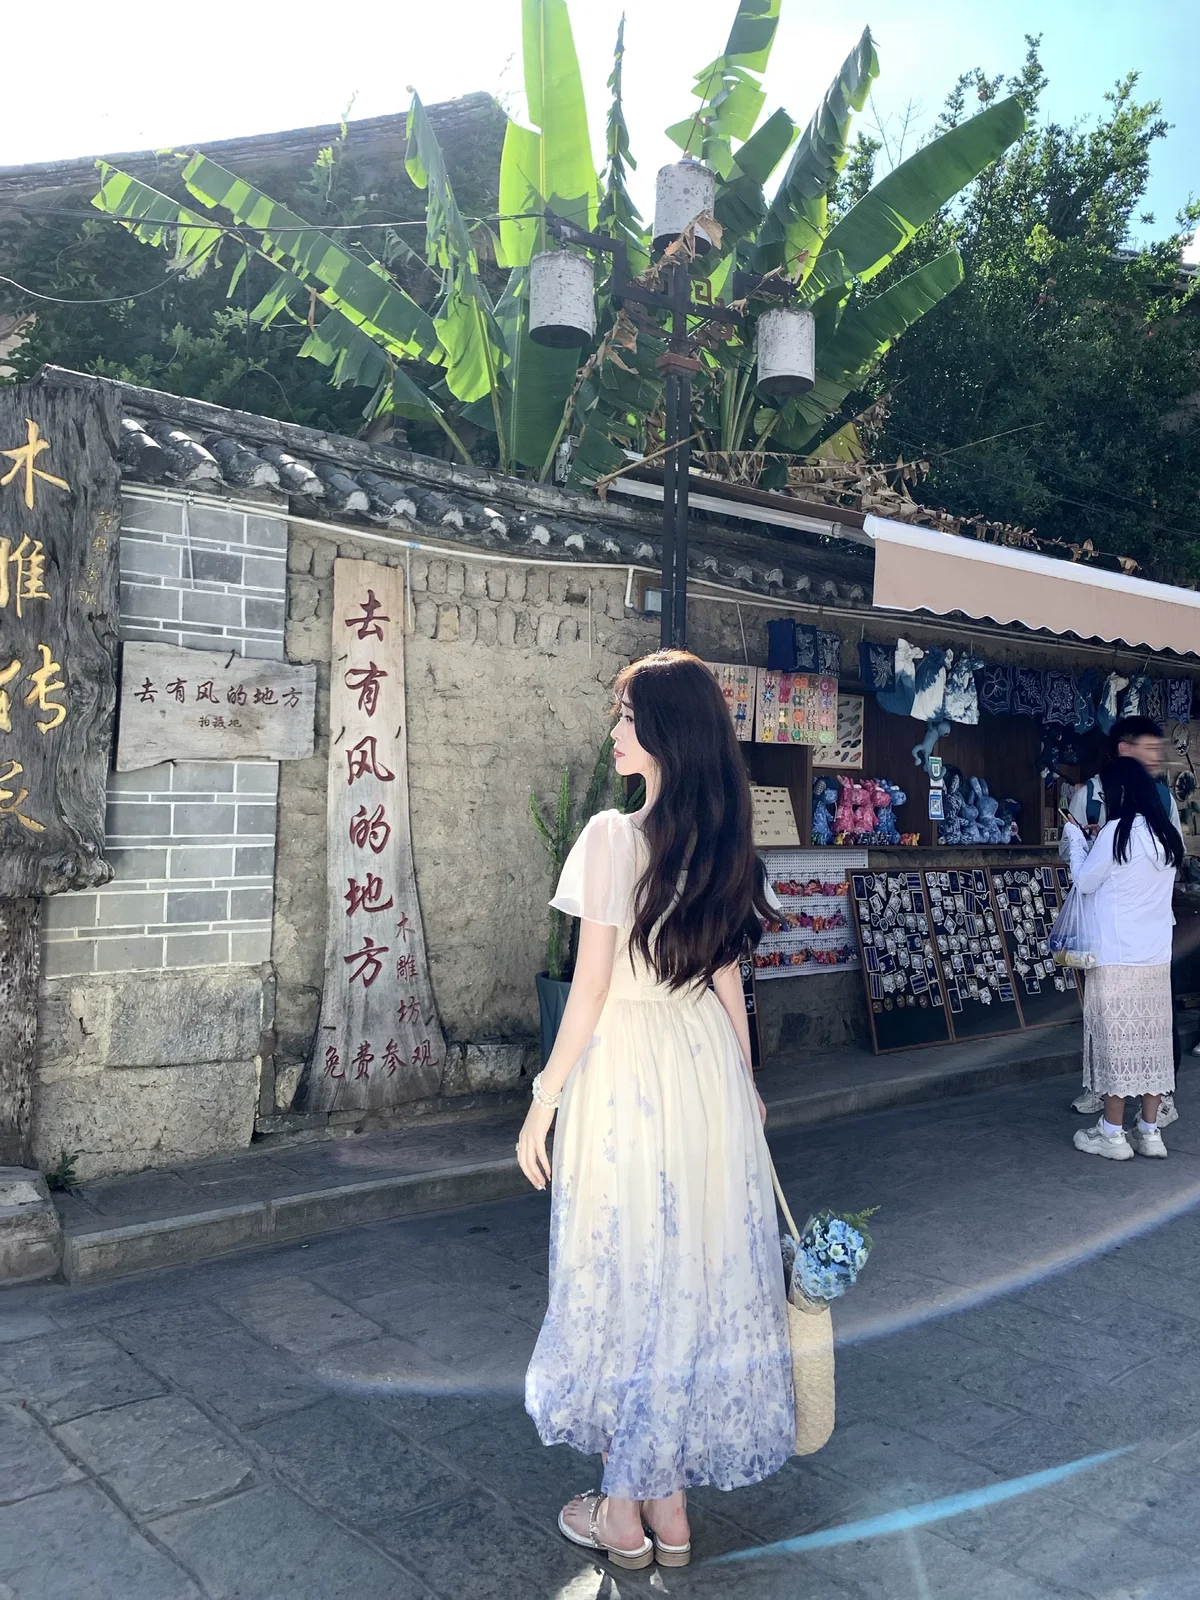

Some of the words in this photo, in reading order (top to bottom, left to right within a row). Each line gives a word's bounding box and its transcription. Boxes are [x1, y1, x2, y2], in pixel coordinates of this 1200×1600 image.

[133, 677, 304, 709] 去有风的地方
[197, 716, 243, 730] 拍摄地
[343, 588, 396, 989] 去有风的地方
[395, 911, 422, 1025] 木雕坊
[323, 1038, 441, 1081] 免费参观
